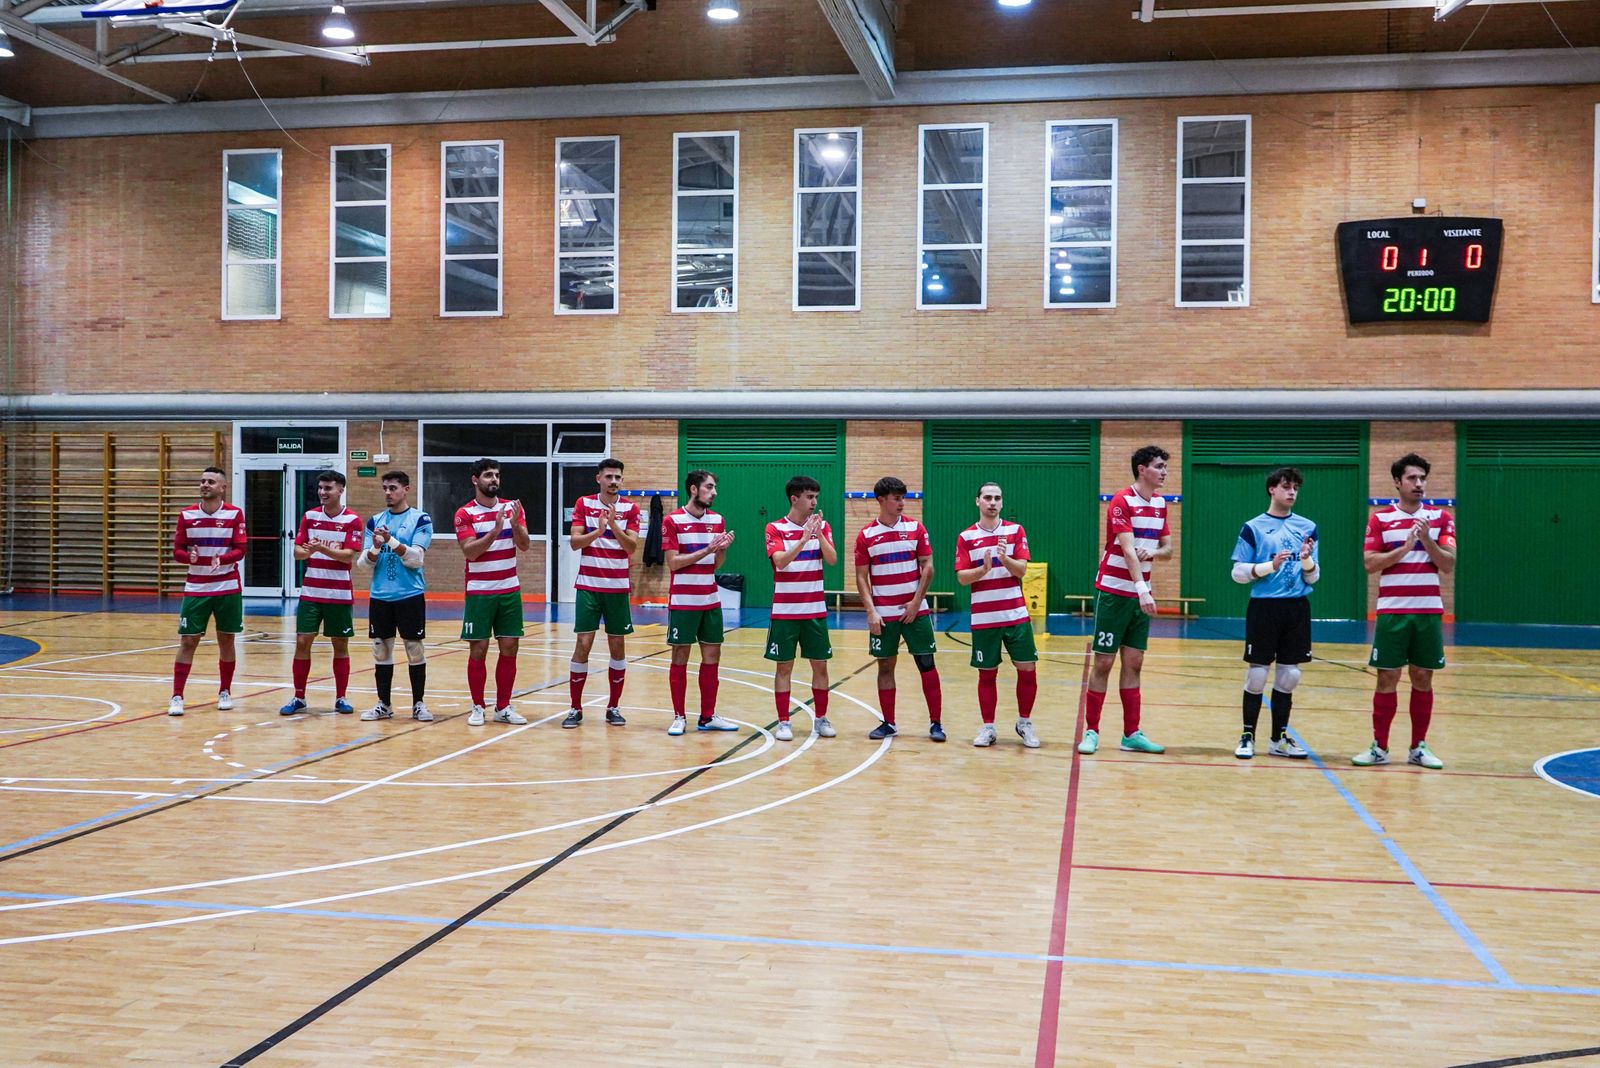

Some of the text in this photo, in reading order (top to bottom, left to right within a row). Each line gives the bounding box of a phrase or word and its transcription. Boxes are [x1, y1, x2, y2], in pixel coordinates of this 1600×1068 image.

[1443, 229, 1482, 237] VISITANTE
[1383, 246, 1398, 270] 0
[1421, 249, 1428, 266] 1
[1467, 244, 1482, 269] 0
[1383, 287, 1456, 312] 20:00
[465, 622, 473, 634] 11
[672, 627, 679, 640] 2
[1097, 631, 1114, 647] 23
[769, 642, 779, 656] 21
[1247, 644, 1253, 655] 1
